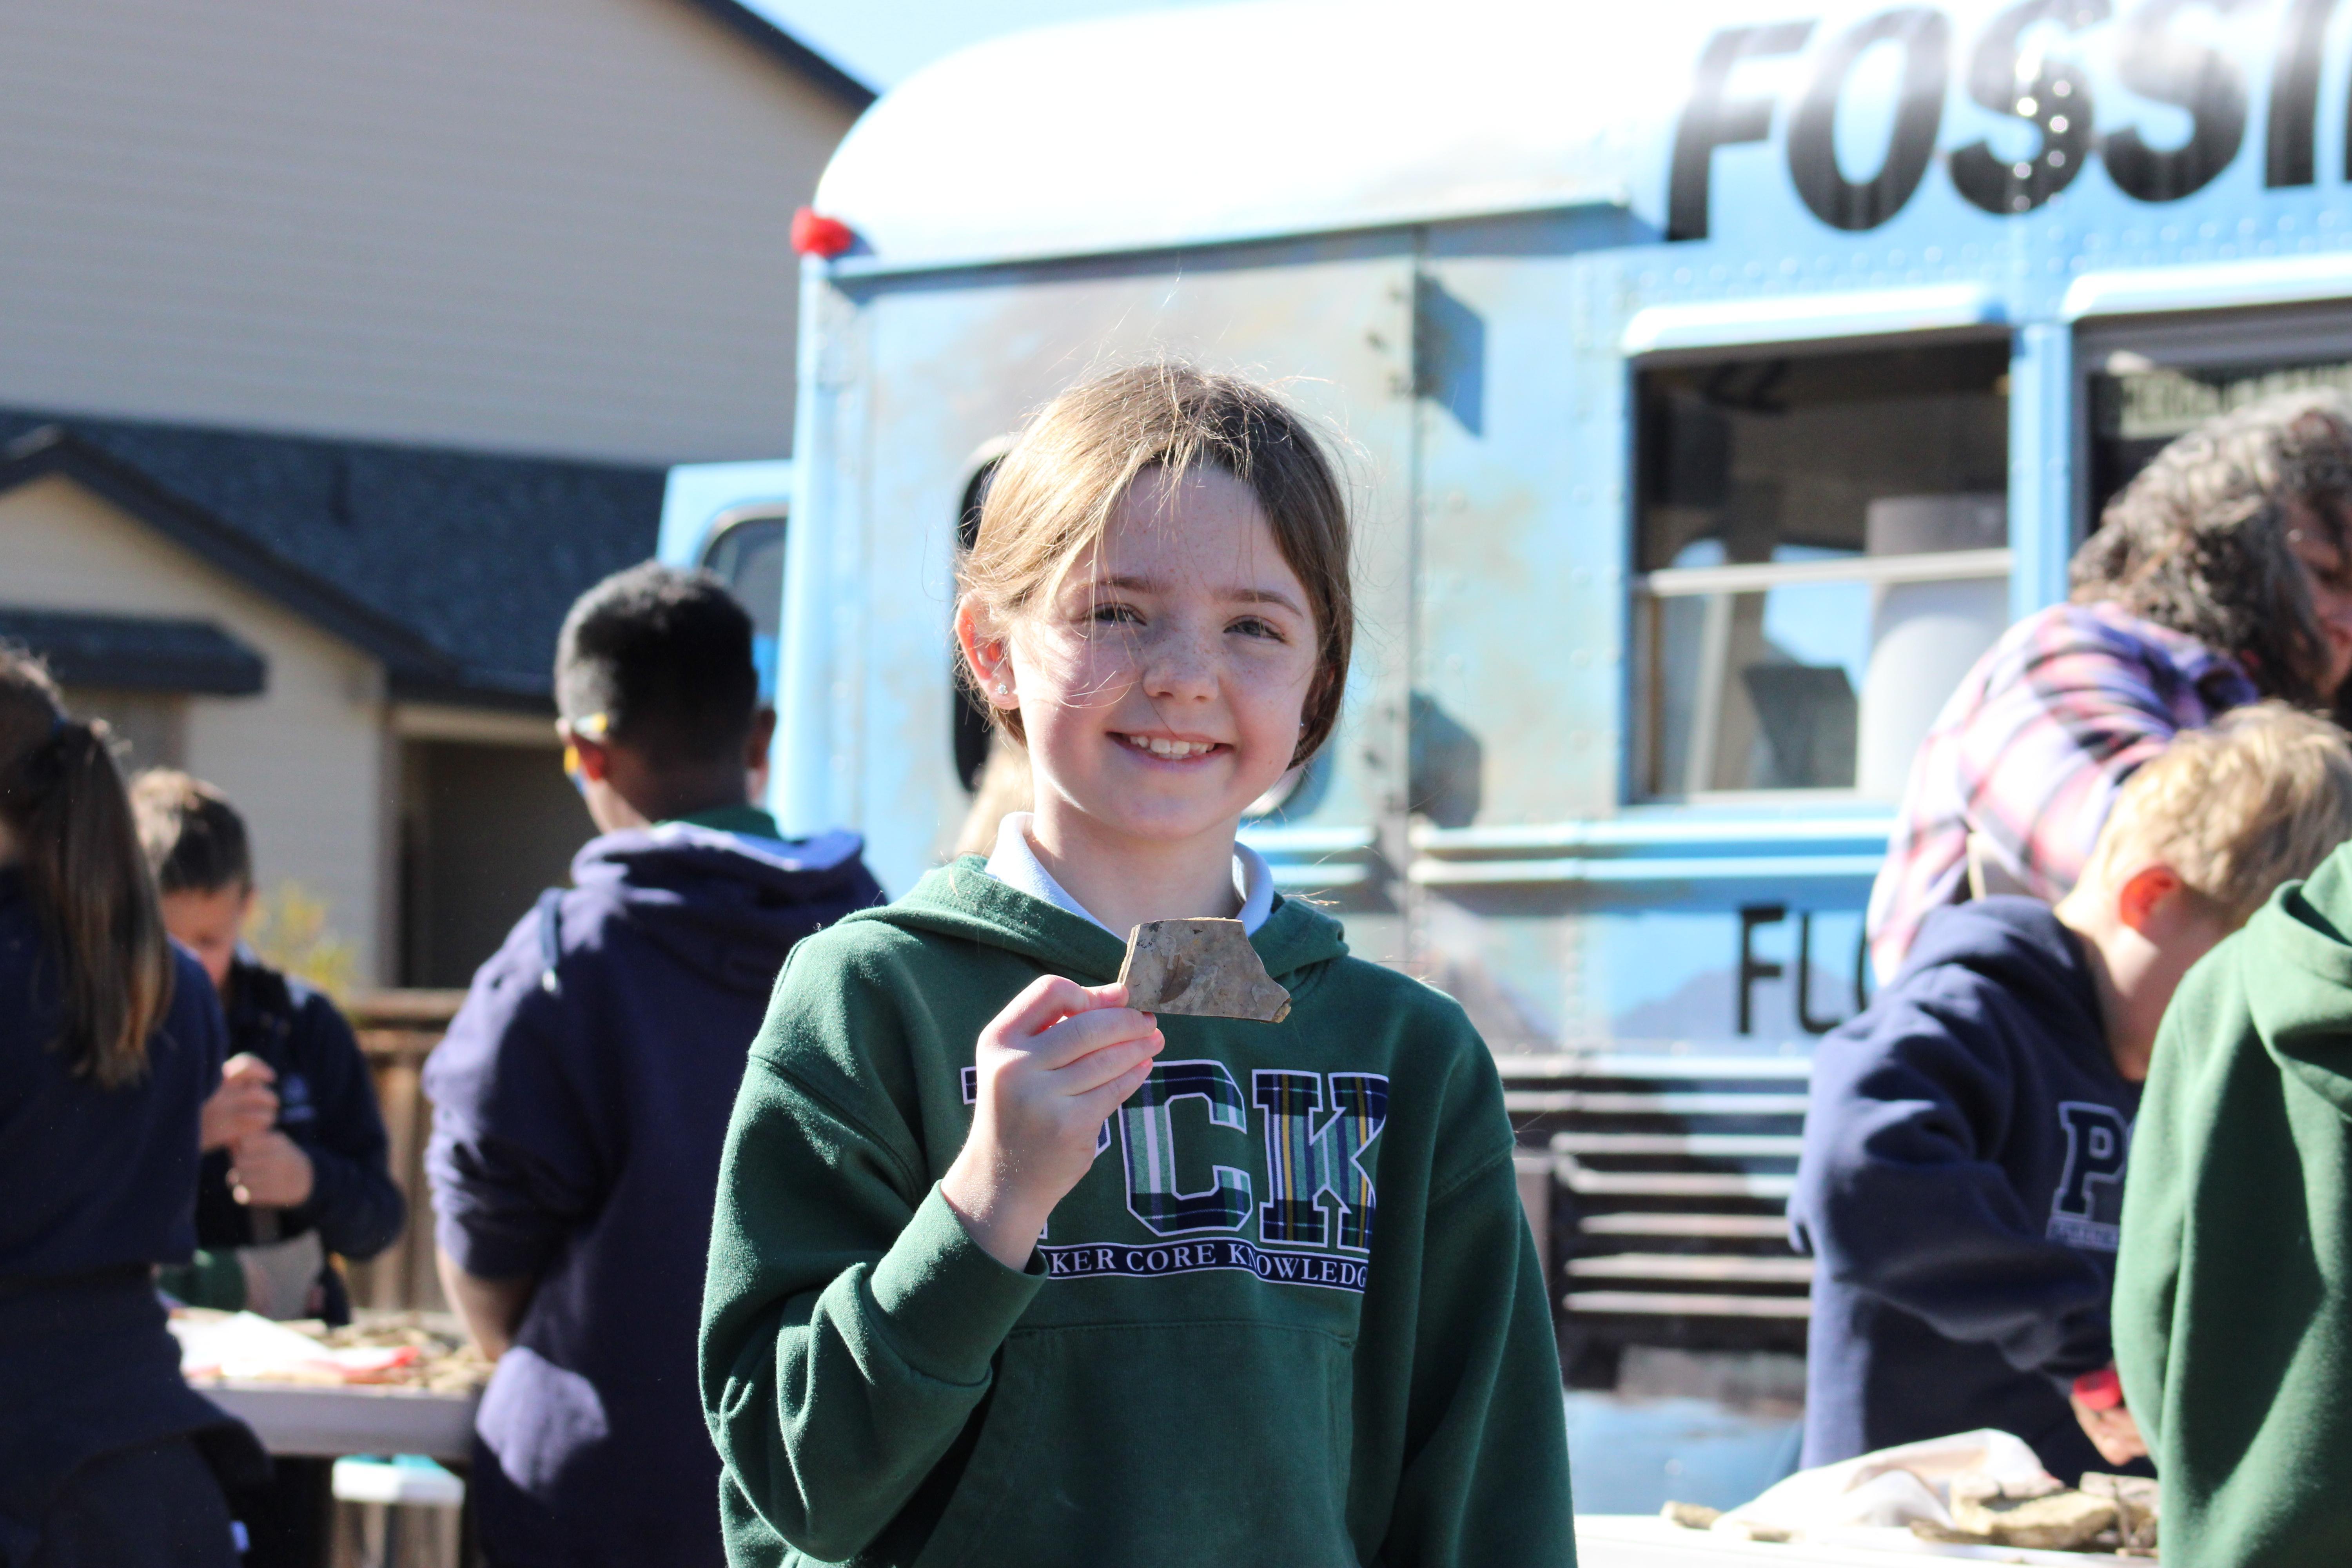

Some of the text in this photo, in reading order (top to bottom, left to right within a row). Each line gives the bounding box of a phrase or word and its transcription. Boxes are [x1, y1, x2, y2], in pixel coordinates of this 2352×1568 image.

[1666, 0, 2352, 241] FOSSI
[1736, 904, 1869, 1036] FL
[961, 1059, 1389, 1253] CK
[2052, 1100, 2140, 1221] P
[1050, 1248, 1116, 1274] KER
[1126, 1243, 1216, 1271] CORE
